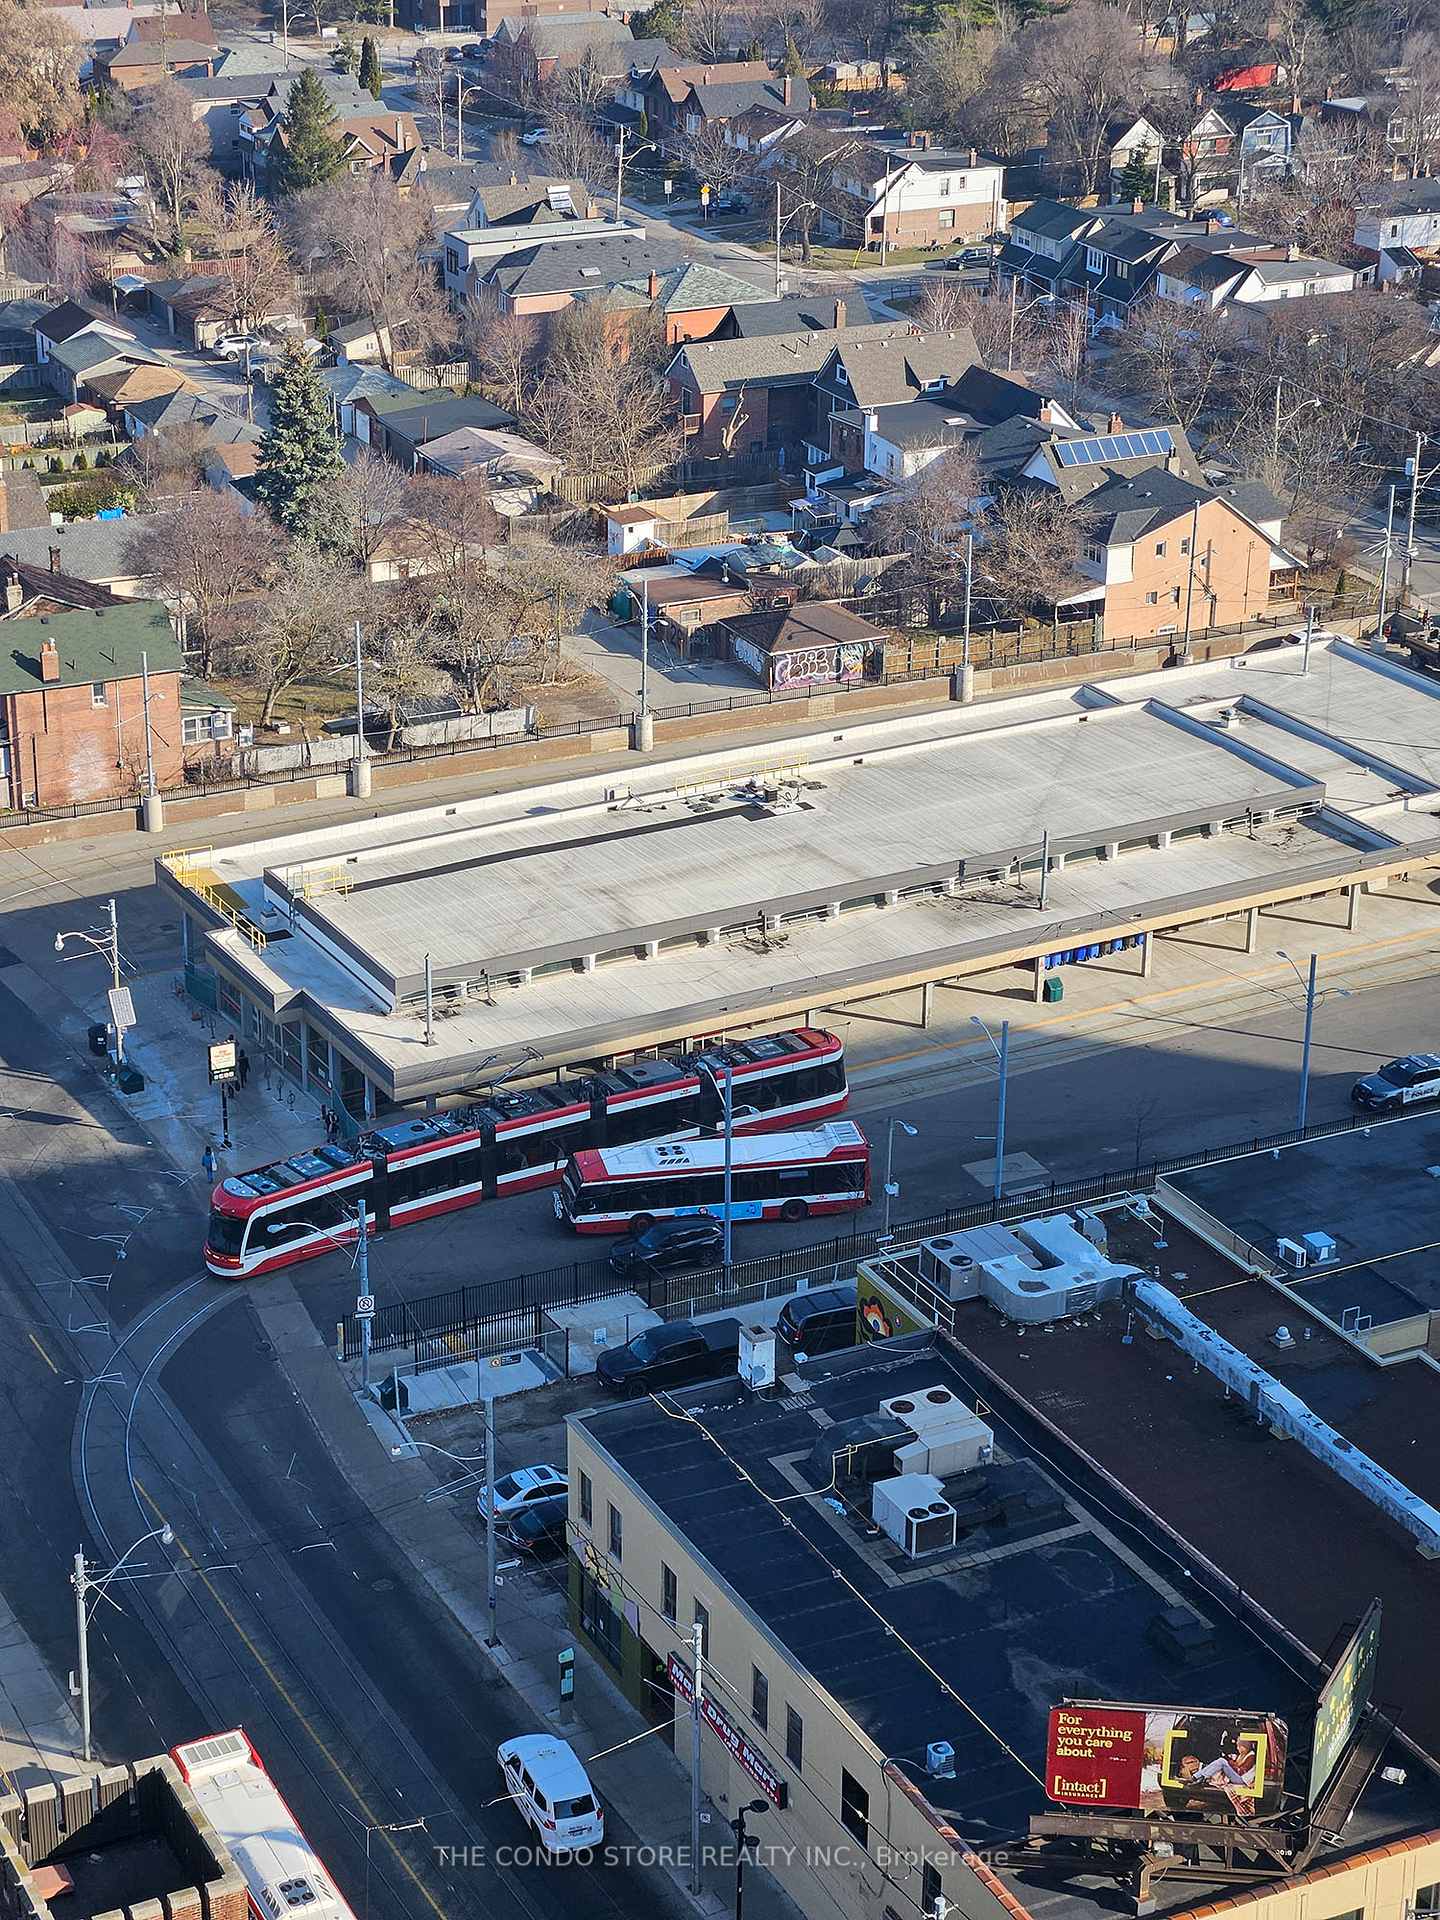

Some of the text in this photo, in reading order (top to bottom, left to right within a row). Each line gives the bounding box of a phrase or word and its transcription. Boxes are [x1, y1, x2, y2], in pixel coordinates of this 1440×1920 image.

[1058, 1712, 1083, 1725] For
[1057, 1725, 1133, 1742] everything
[706, 1704, 740, 1749] Drug
[742, 1745, 778, 1791] Mart
[1057, 1736, 1113, 1748] you care
[1055, 1746, 1096, 1758] about.
[1061, 1791, 1098, 1799] INSURANCE
